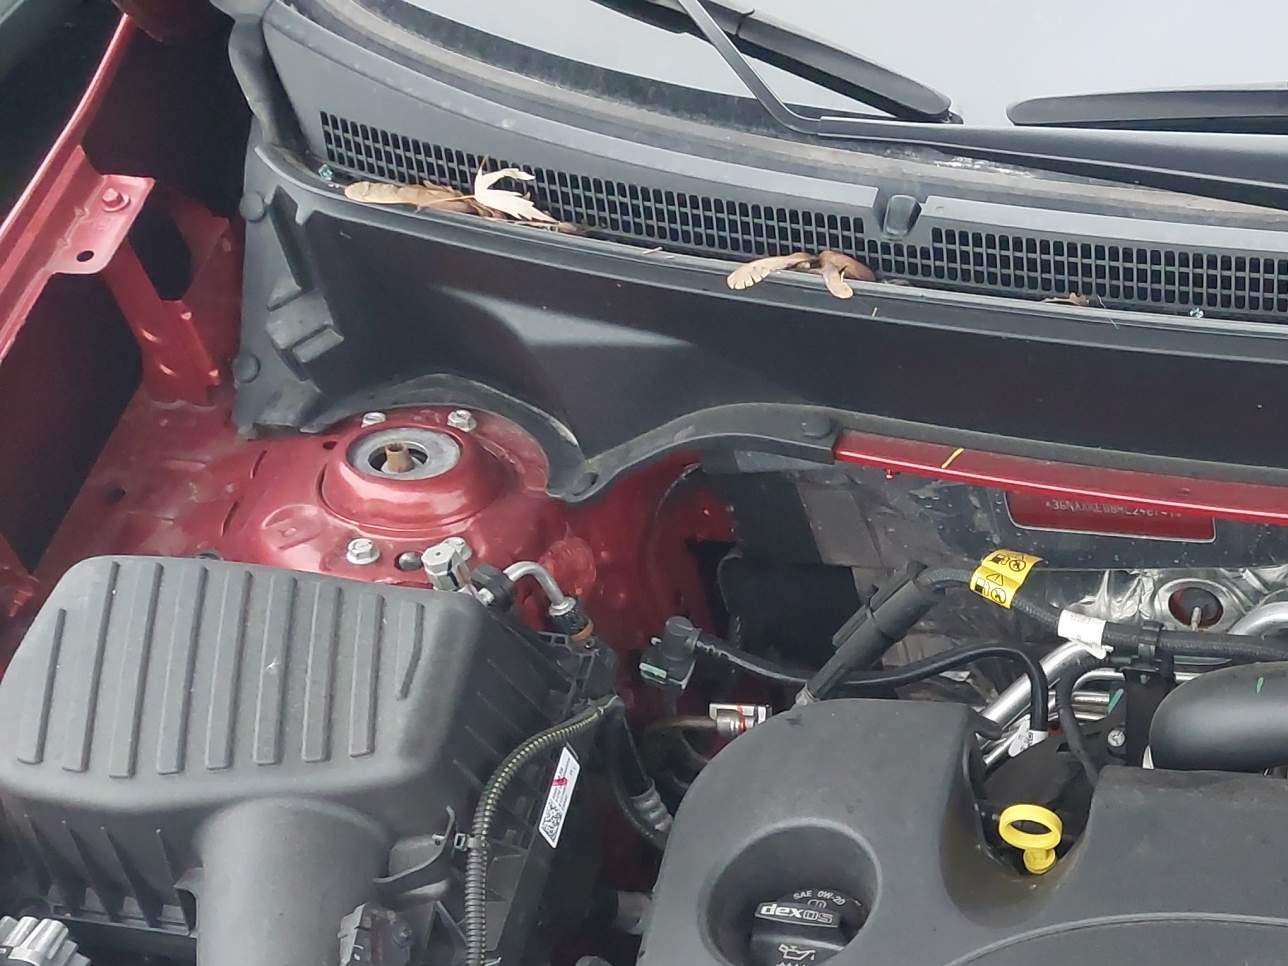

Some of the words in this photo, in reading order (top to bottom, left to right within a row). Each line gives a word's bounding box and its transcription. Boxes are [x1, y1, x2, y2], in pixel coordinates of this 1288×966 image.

[793, 890, 813, 900] SAE
[817, 890, 846, 905] 0W-20
[760, 903, 834, 923] dexos
